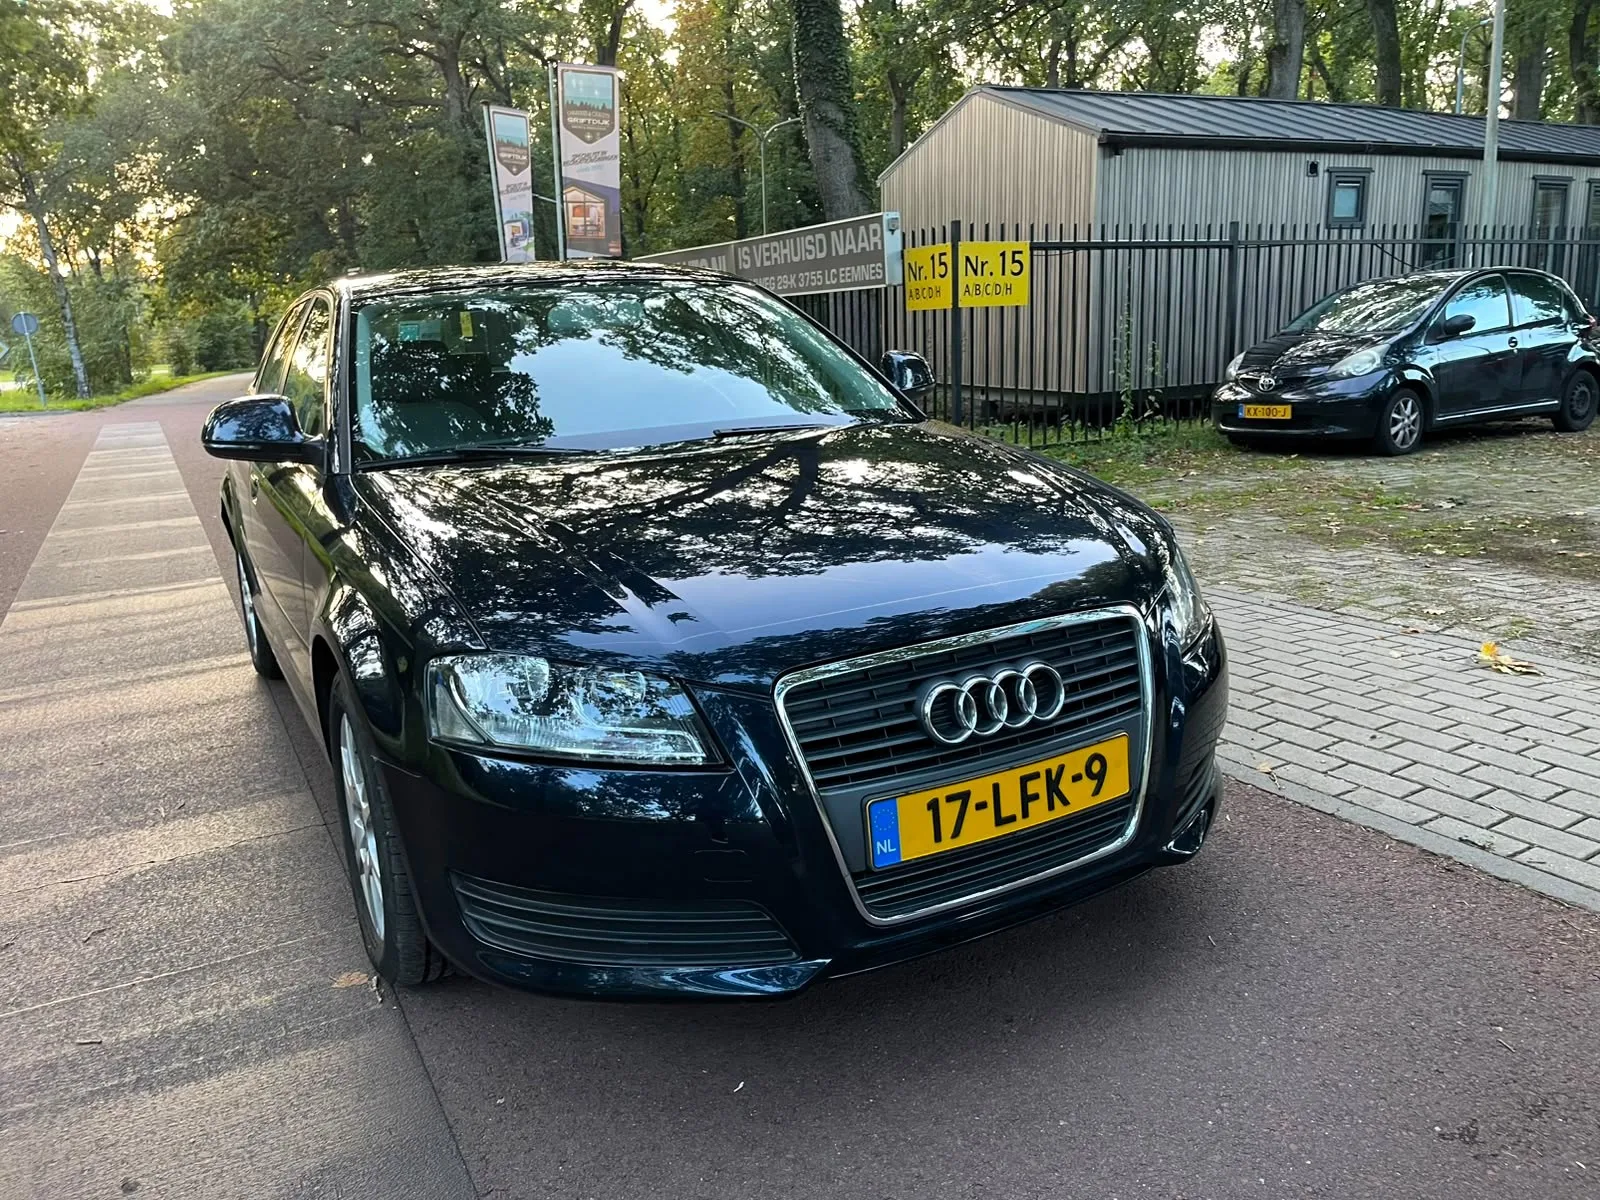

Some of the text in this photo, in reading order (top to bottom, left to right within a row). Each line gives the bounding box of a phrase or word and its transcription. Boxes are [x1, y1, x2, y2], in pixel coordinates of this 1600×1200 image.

[738, 247, 751, 270] IS
[753, 233, 827, 268] VERHUISD
[830, 223, 882, 257] NAAR
[777, 271, 797, 290] 29-K
[799, 270, 823, 289] 3755
[825, 268, 838, 285] LC
[839, 263, 883, 283] EEMNES
[908, 252, 948, 282] Nr. 15
[965, 250, 1024, 277] Nr. 15
[876, 752, 1107, 855] NL 17-LFK-9
